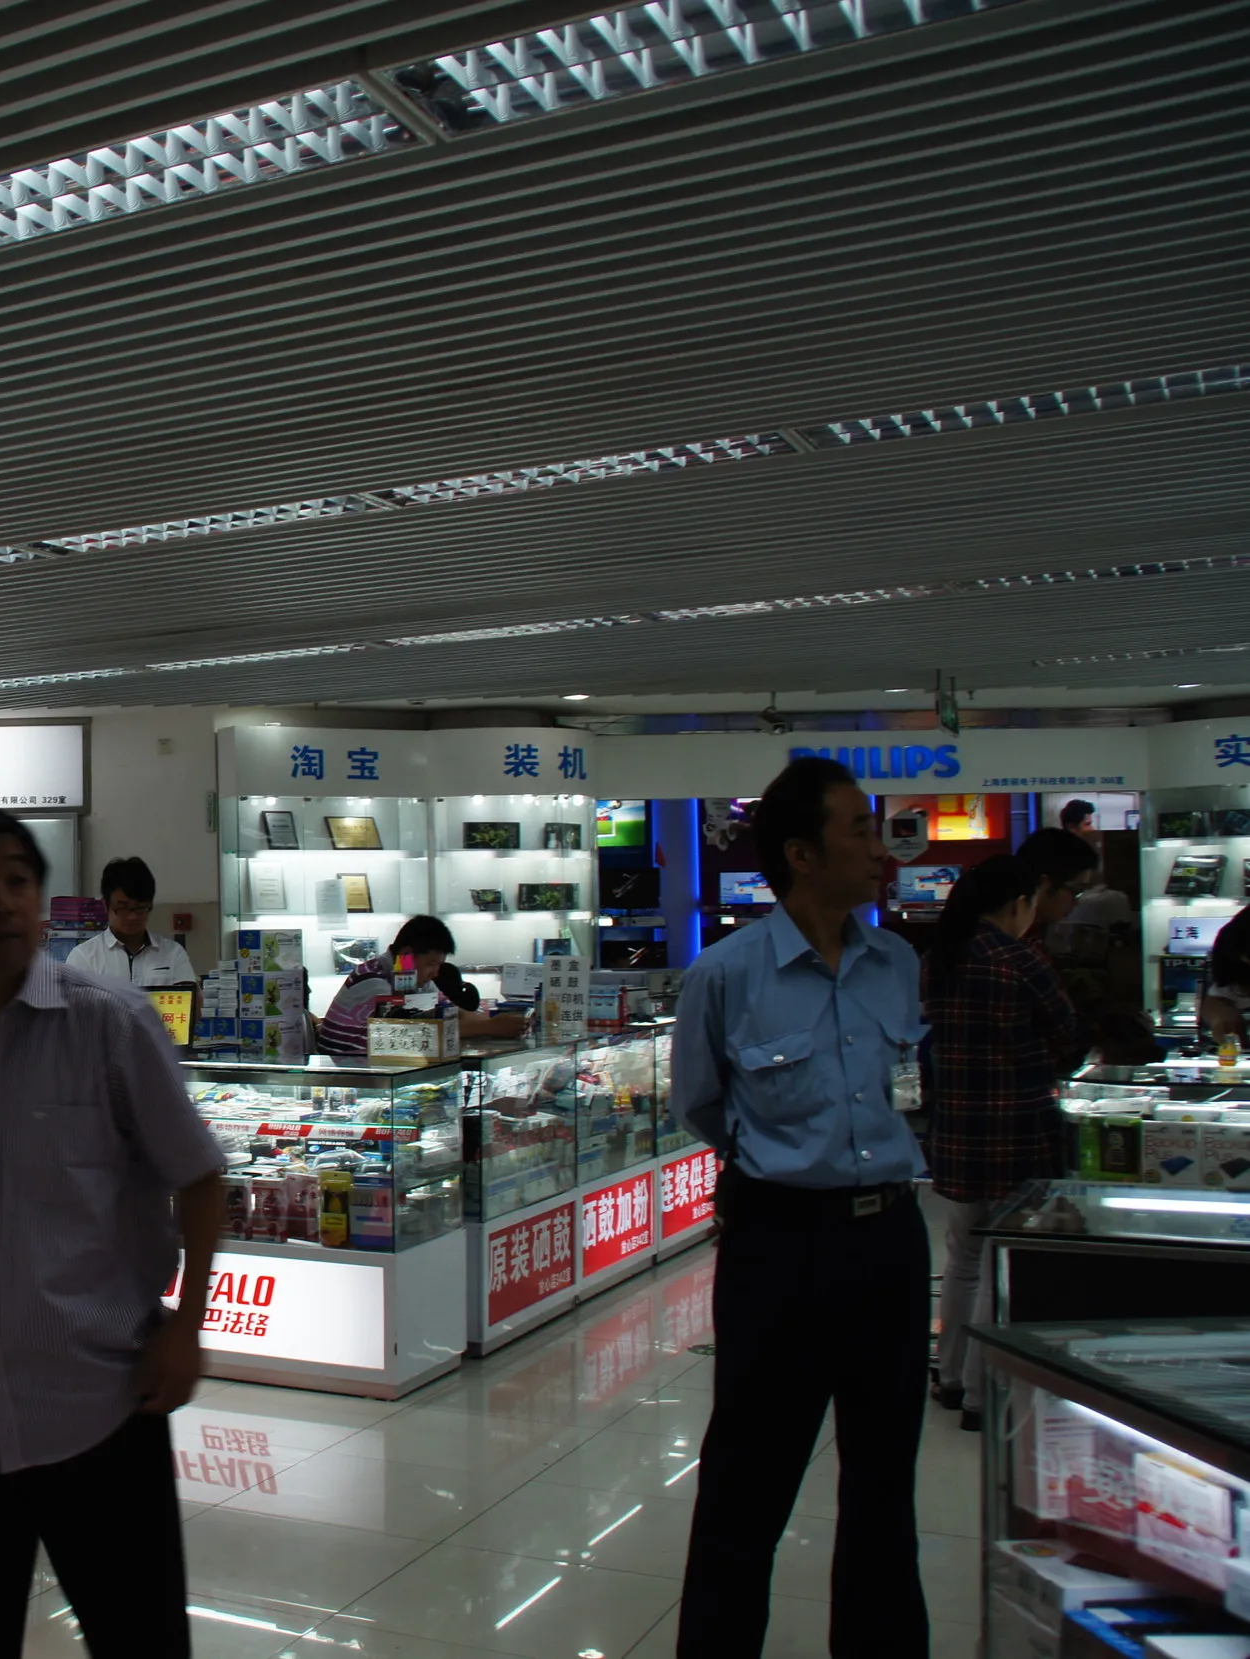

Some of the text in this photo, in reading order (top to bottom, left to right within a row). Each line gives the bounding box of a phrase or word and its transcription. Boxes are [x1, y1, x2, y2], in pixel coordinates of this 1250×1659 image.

[290, 742, 588, 781] 淘宝 装机
[41, 795, 67, 805] 329室
[489, 1212, 572, 1292] 原装硒鼓
